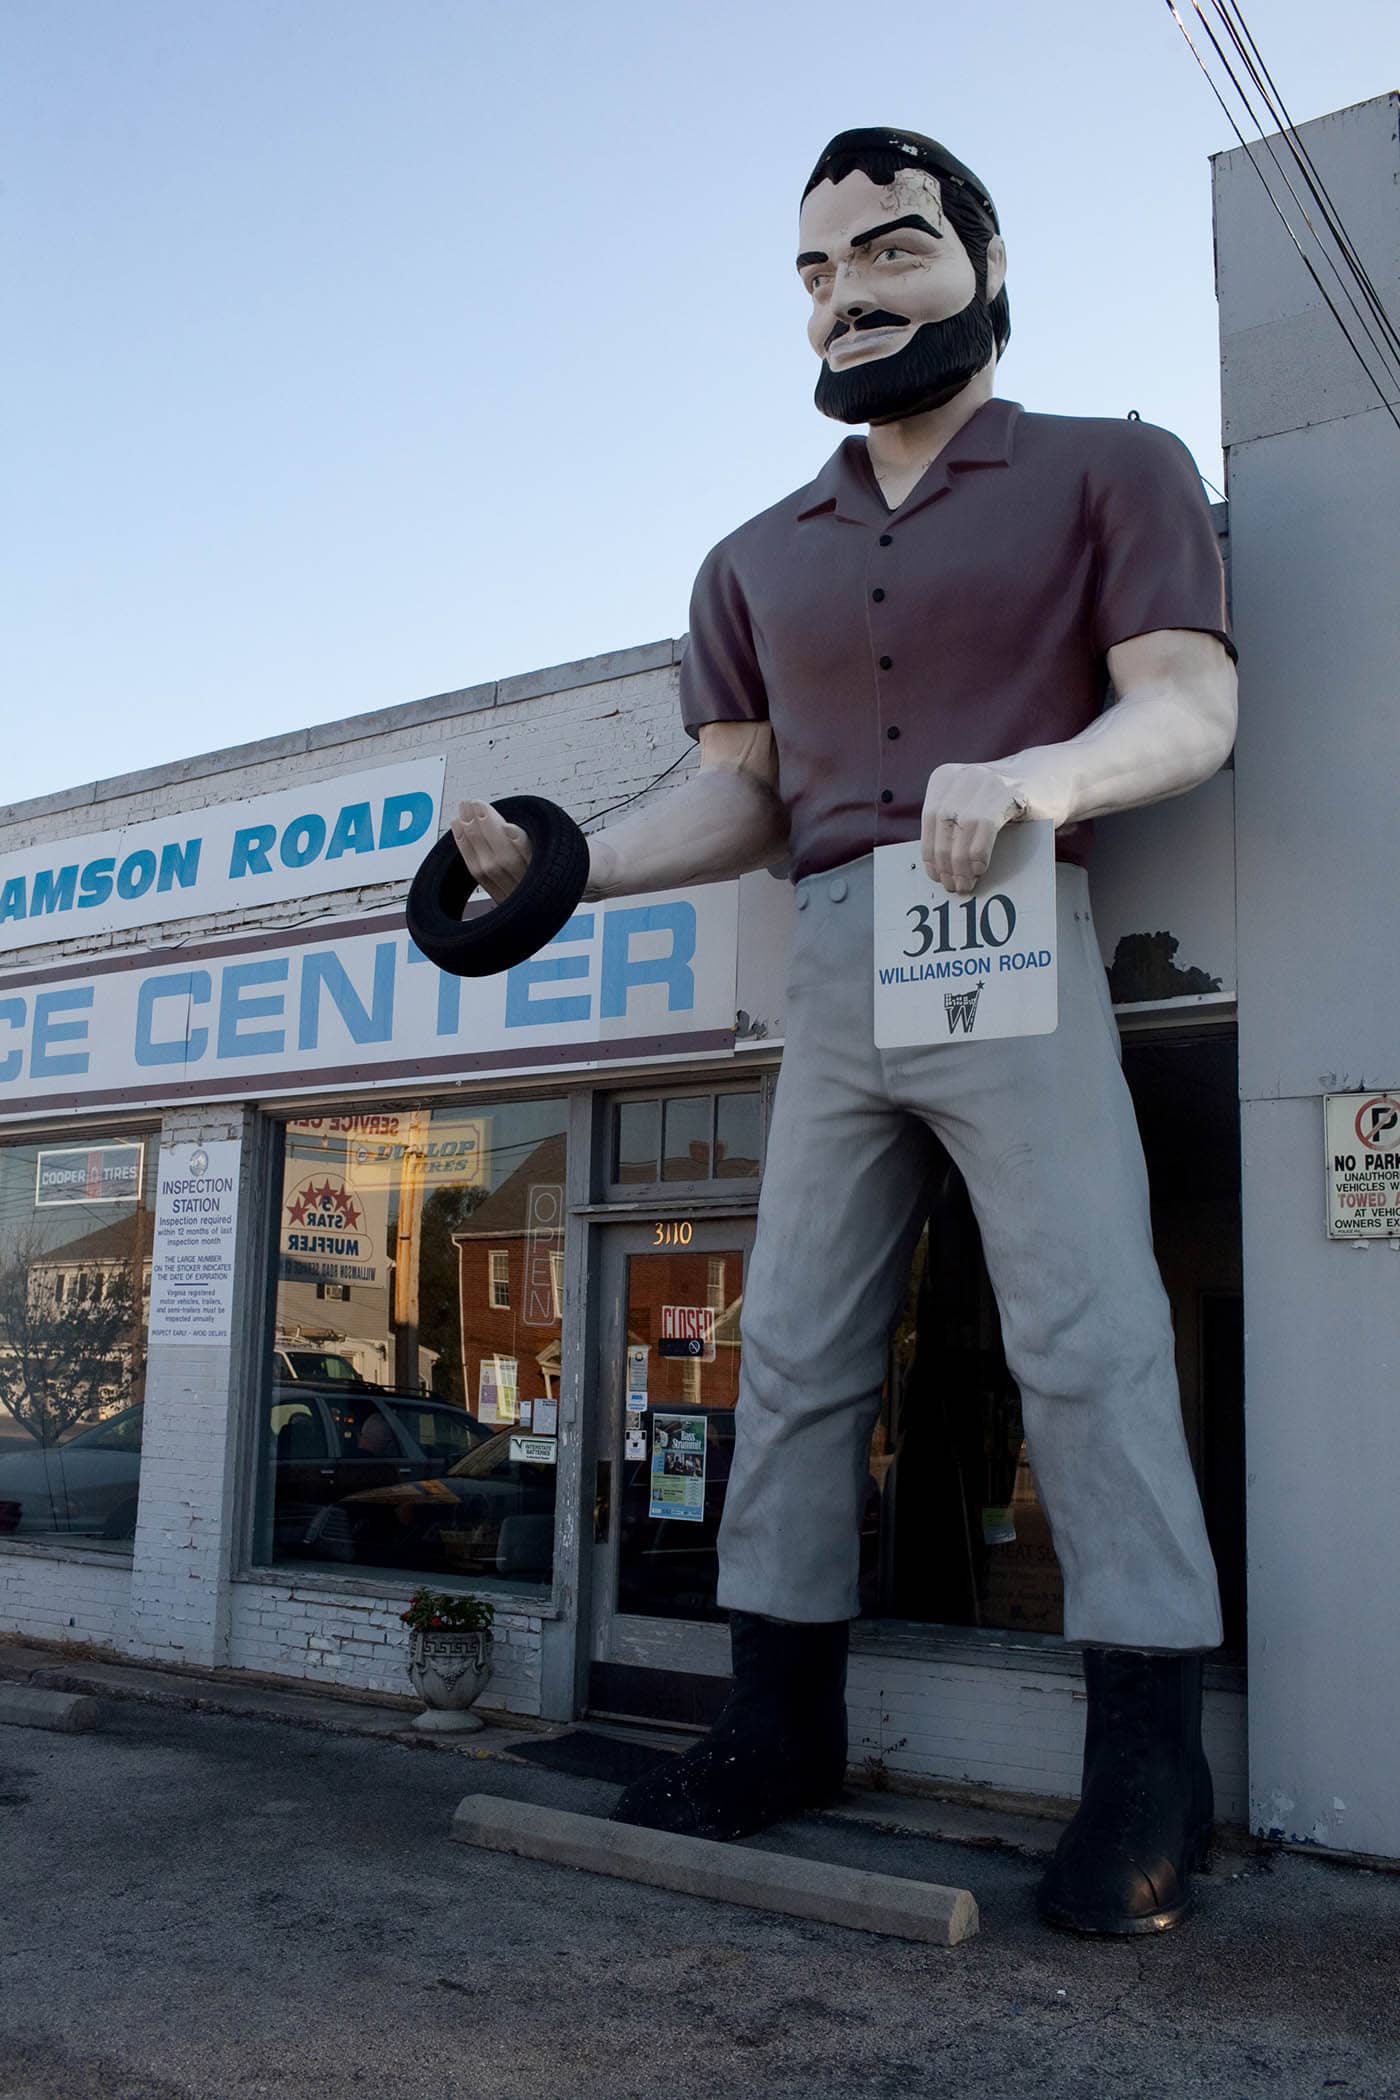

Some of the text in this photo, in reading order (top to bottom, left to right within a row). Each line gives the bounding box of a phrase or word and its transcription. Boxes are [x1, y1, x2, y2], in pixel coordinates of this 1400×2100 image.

[0, 791, 433, 924] AMSON ROAD
[903, 894, 1017, 957] 3110
[879, 950, 1052, 985] WILLIAMSON ROAD
[1335, 1155, 1356, 1171] NO
[42, 1166, 137, 1185] COOPER TIRES
[1344, 1171, 1400, 1182] UNAUTHOR
[162, 1178, 233, 1195] INSPECTION
[1336, 1182, 1385, 1192] VEHICLES
[172, 1197, 220, 1213] STATION
[1338, 1192, 1387, 1208] TOWED
[1354, 1208, 1366, 1217] AT
[160, 1215, 232, 1227] Inspection required
[1334, 1218, 1382, 1229] OWNERS
[211, 1227, 218, 1235] of
[653, 1222, 693, 1245] 3110
[167, 1238, 199, 1246] inspection
[530, 1192, 557, 1319] OPEN
[177, 1264, 201, 1272] STICKER
[170, 1273, 183, 1281] DATE
